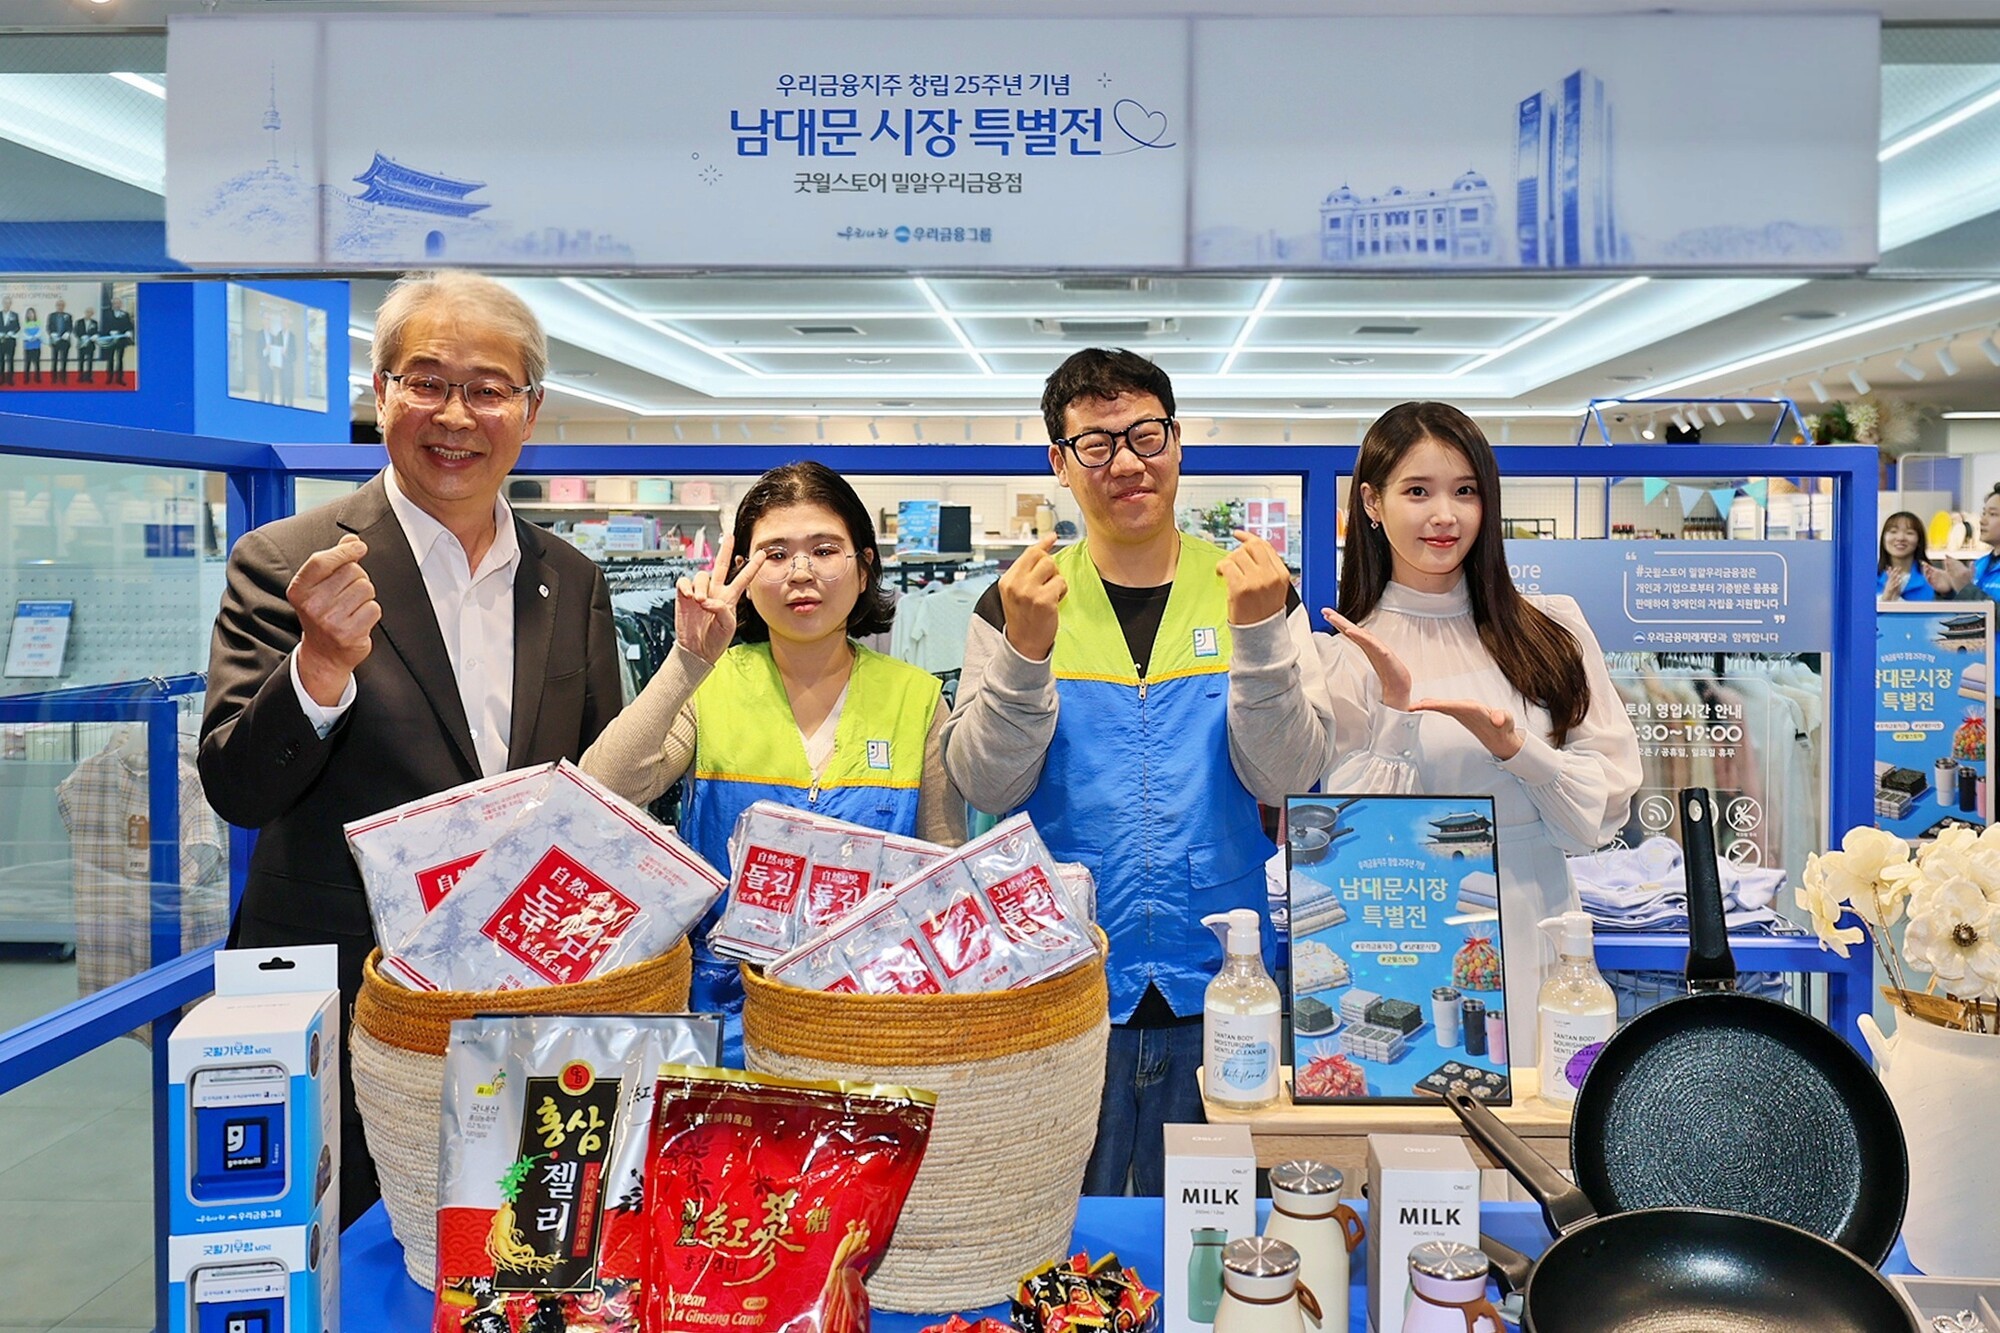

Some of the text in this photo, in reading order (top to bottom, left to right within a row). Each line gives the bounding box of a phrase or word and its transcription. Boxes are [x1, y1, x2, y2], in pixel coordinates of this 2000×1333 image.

[776, 74, 1070, 97] 우리금융지주 창립 25주년 기념
[730, 108, 1102, 158] 남대문 시장 특별전
[793, 172, 1022, 194] 굿윌스토어 밀알우리금융점
[913, 227, 992, 243] 우리금융그룹
[1636, 583, 1661, 594] 개인과
[1664, 583, 1714, 594] 기업으로부터
[1635, 599, 1669, 610] 판매하여
[1736, 599, 1779, 610] 지원합니다
[1882, 692, 1934, 711] 특별전
[1656, 703, 1710, 719] 영업시간
[1714, 703, 1742, 719] 안내
[743, 863, 796, 896] 돌김
[1339, 876, 1449, 902] 남대문시장
[1361, 905, 1427, 929] 특별전
[1553, 1032, 1577, 1041] TANTAN
[255, 1047, 272, 1055] MINI
[471, 1103, 500, 1114] 국내산
[536, 1096, 605, 1156] 홍삼
[227, 1157, 261, 1169] goodwill
[536, 1161, 578, 1242] 젤리
[1182, 1188, 1239, 1205] MILK
[1399, 1207, 1461, 1226] MILK
[685, 1309, 730, 1326] Ginseng
[731, 1312, 767, 1326] Candy
